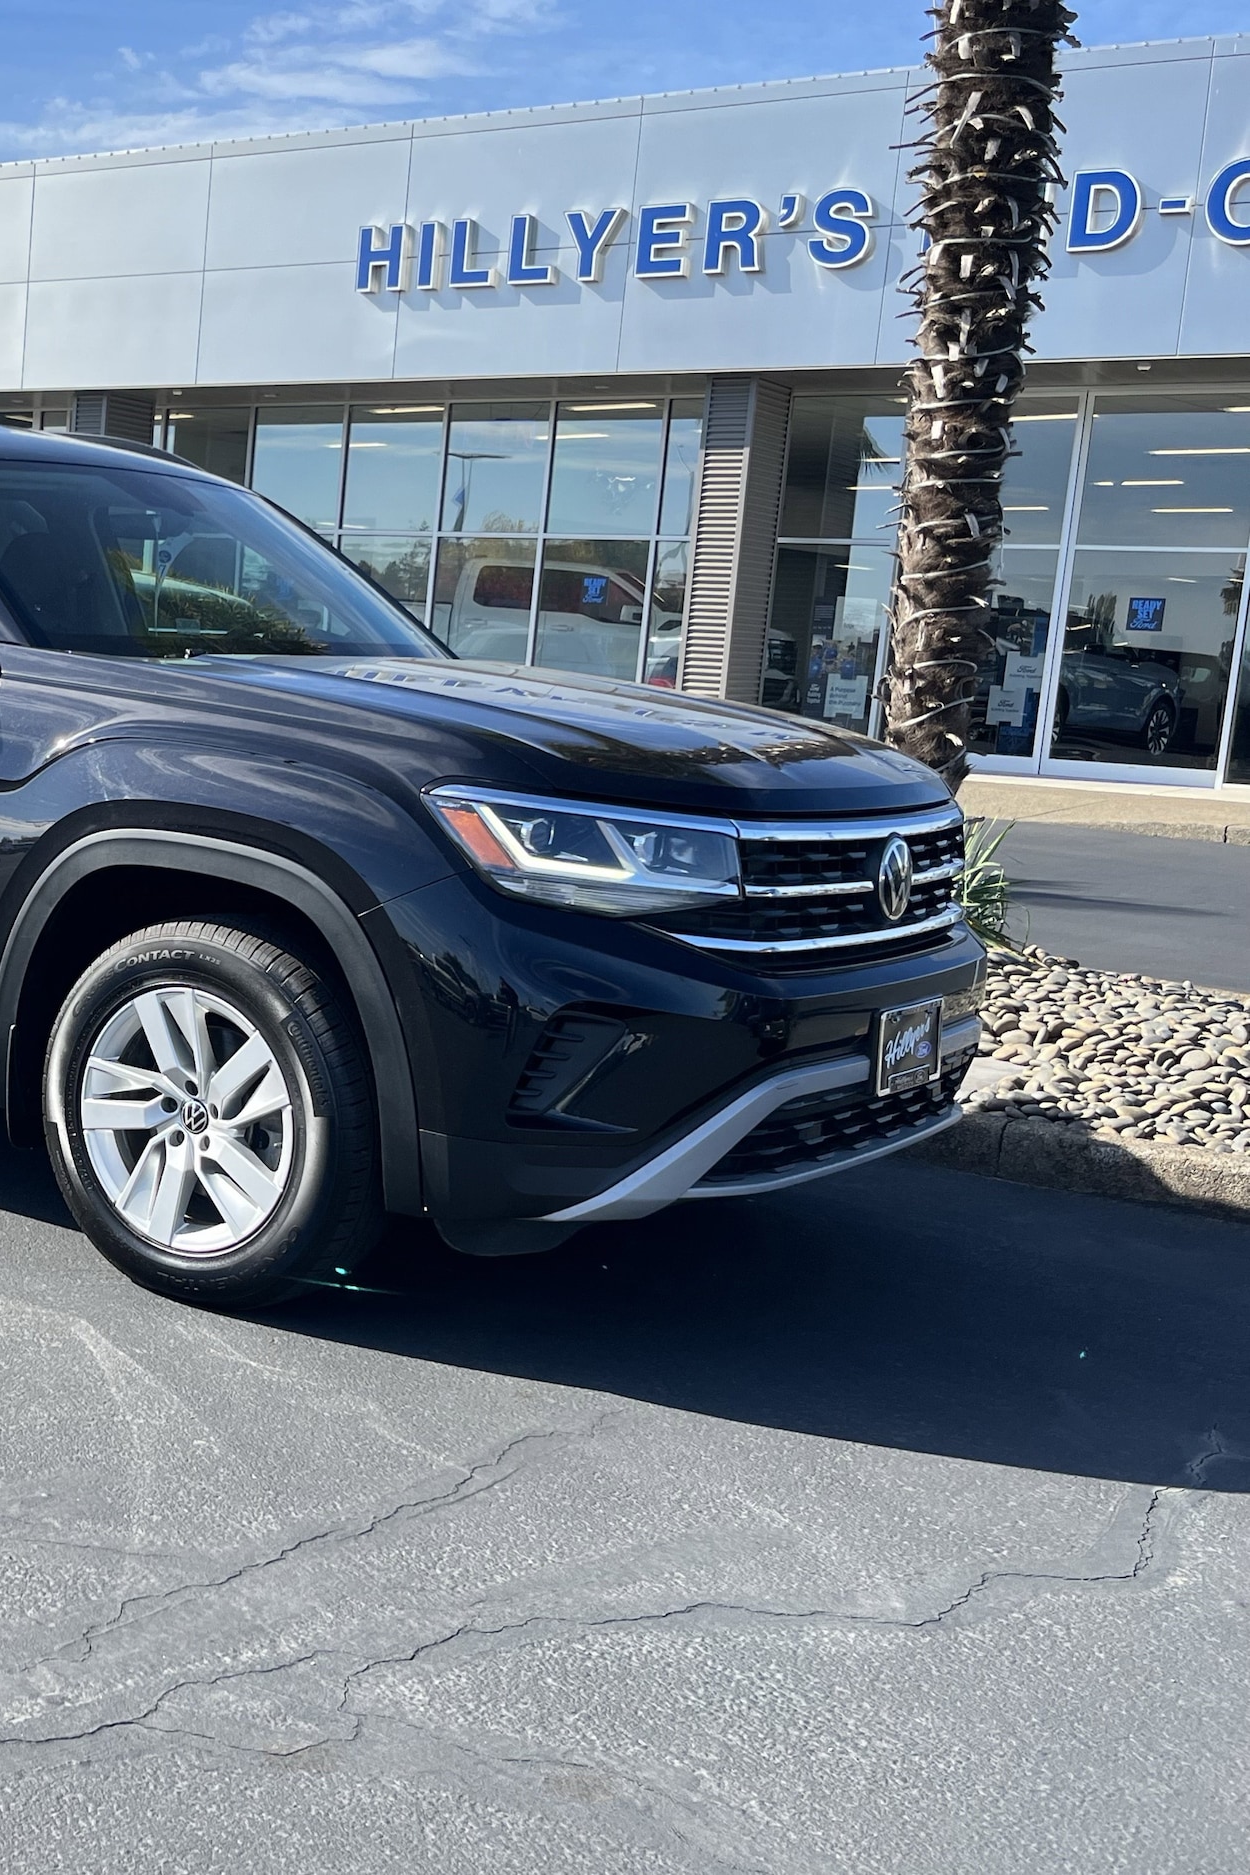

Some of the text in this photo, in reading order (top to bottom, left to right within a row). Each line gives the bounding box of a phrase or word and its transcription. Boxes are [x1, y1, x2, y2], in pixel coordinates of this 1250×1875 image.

[356, 186, 875, 295] HILLYER'S
[1131, 599, 1162, 610] READY
[1137, 609, 1154, 619] SET
[1129, 618, 1158, 629] Ford
[1016, 665, 1037, 673] Ford
[997, 699, 1015, 708] Ford
